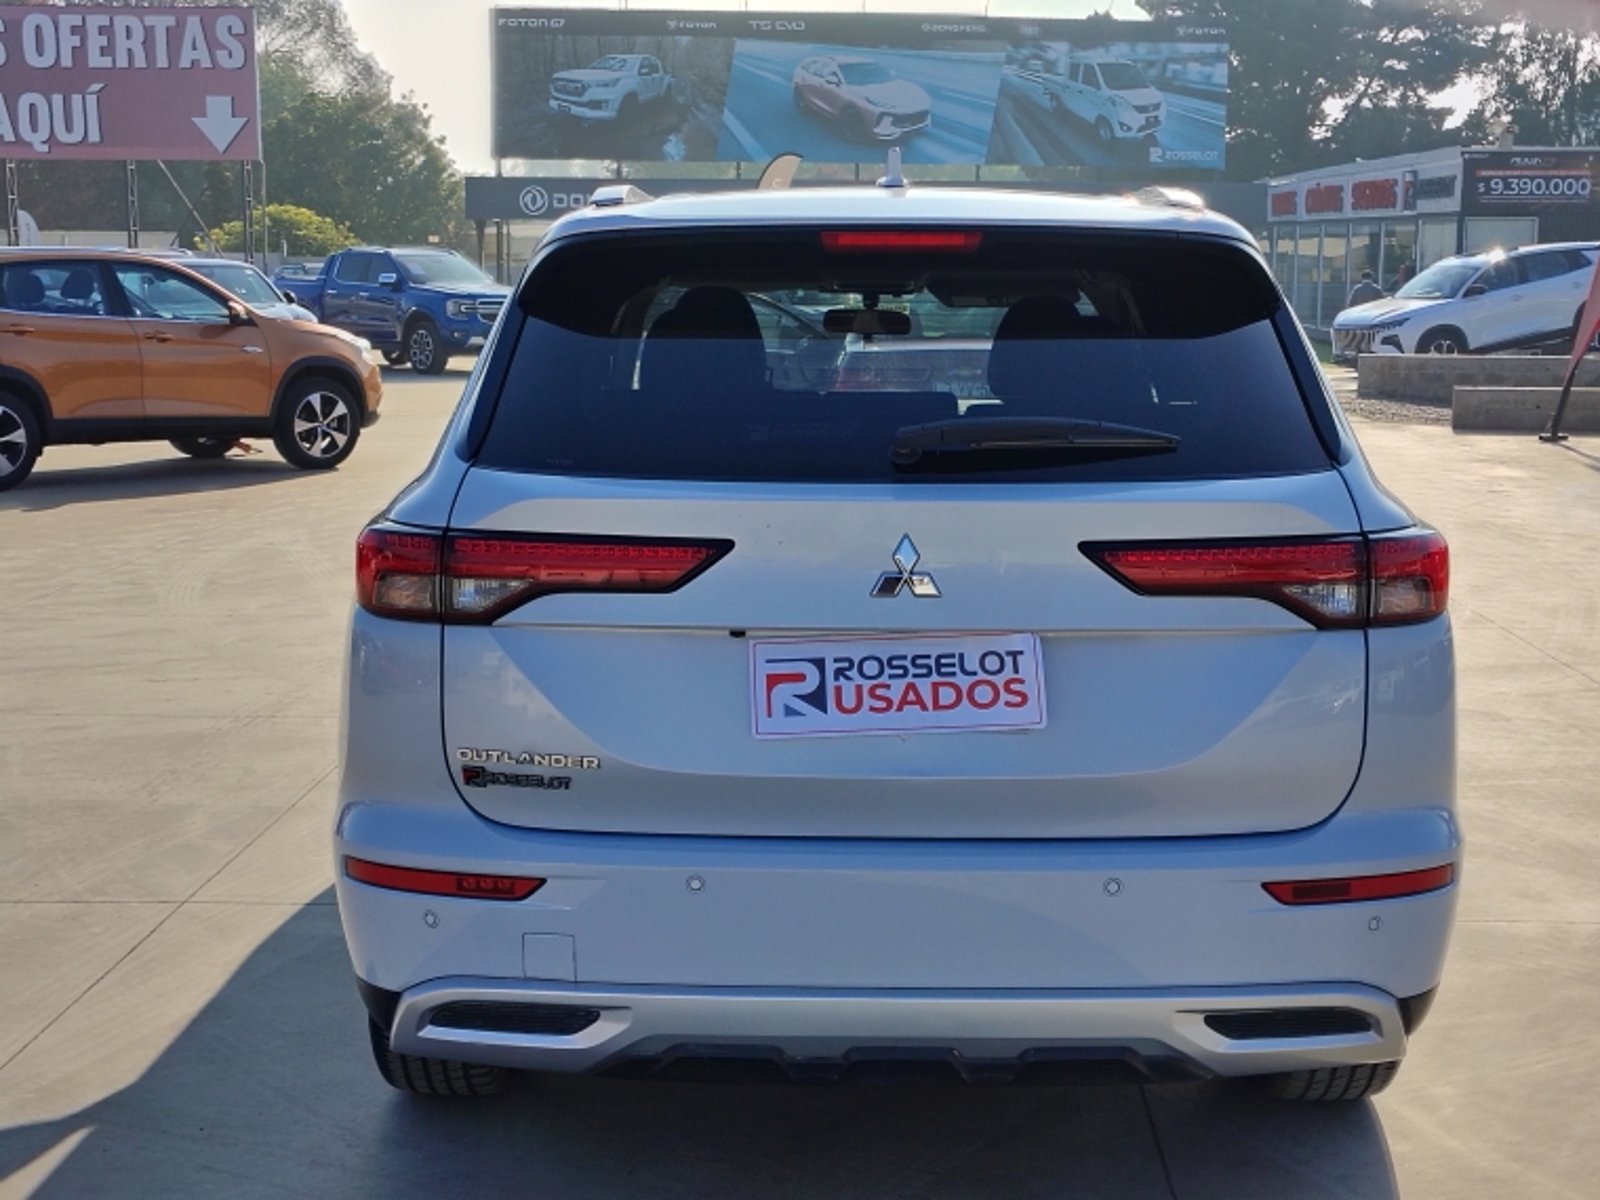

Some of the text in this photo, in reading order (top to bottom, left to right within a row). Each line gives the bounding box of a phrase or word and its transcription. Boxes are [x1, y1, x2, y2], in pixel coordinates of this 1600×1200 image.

[498, 18, 548, 27] FOTON
[22, 13, 246, 69] OFERTAS
[1164, 151, 1219, 161] ROSSELOT
[1490, 178, 1592, 195] 9.390.000
[833, 650, 1024, 682] ROSSELOT
[832, 677, 1029, 715] USADOS
[456, 747, 601, 769] OUTLANDER
